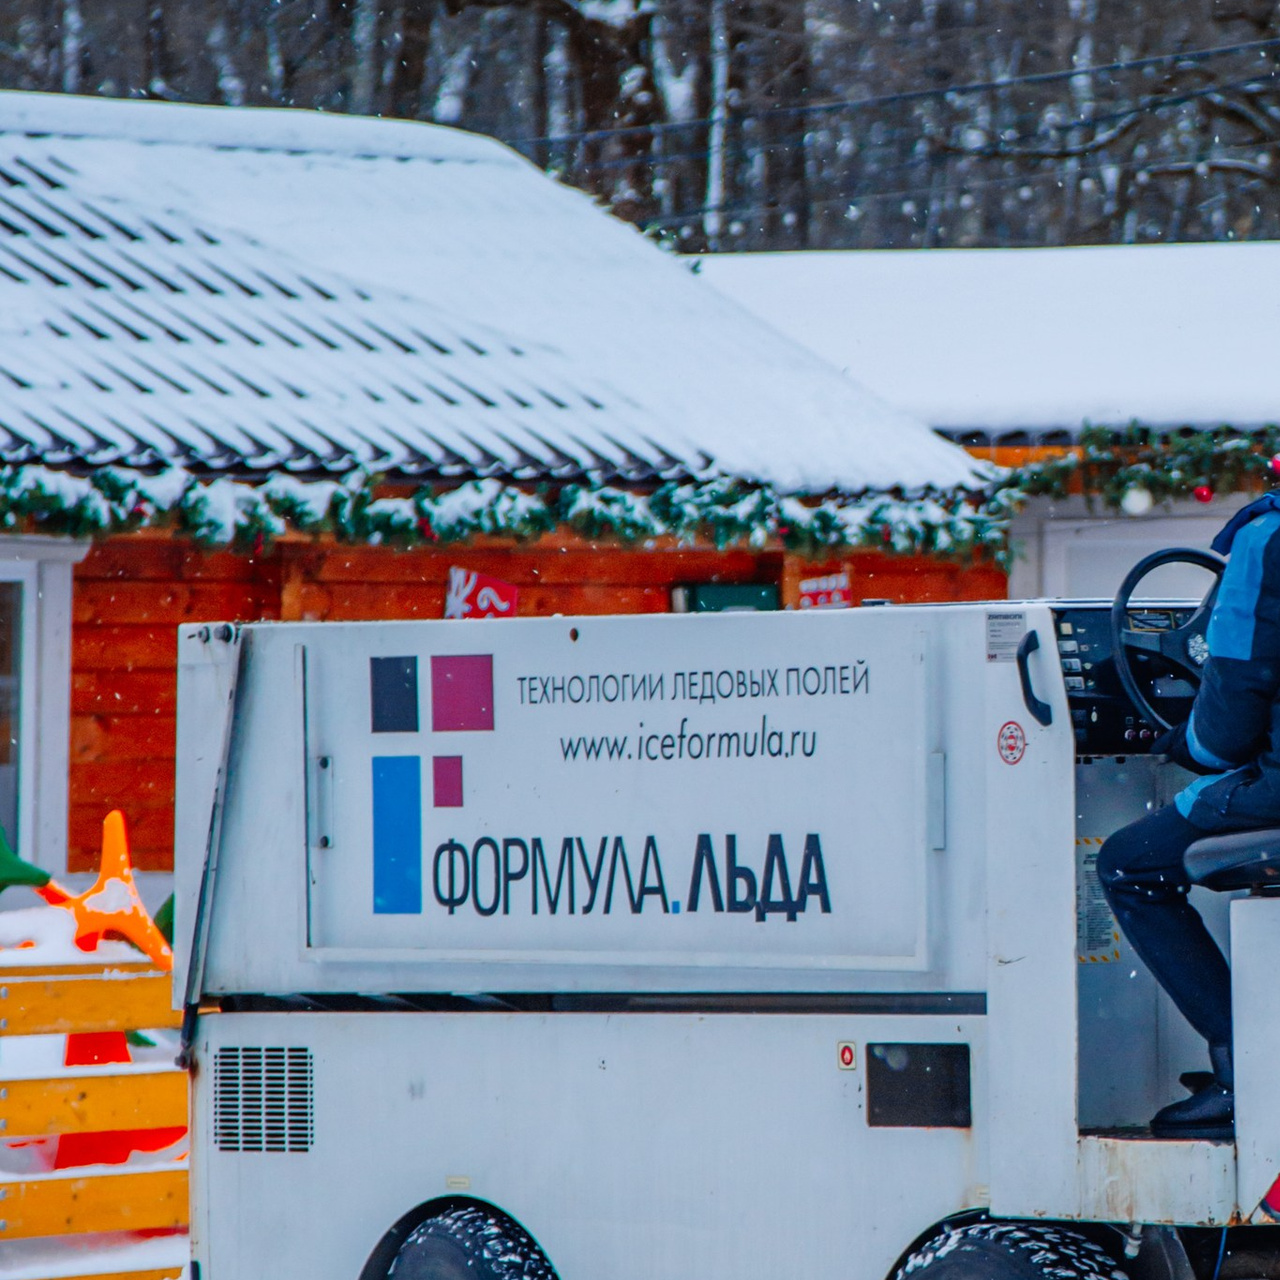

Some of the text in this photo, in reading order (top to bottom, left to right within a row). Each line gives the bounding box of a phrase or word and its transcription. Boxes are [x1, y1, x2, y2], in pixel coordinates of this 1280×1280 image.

[516, 659, 869, 705] ТЕХНОЛОГИИ ЛЕДОВЫХ ПОЛЕЙ
[560, 714, 816, 761] www.iceformula.ru
